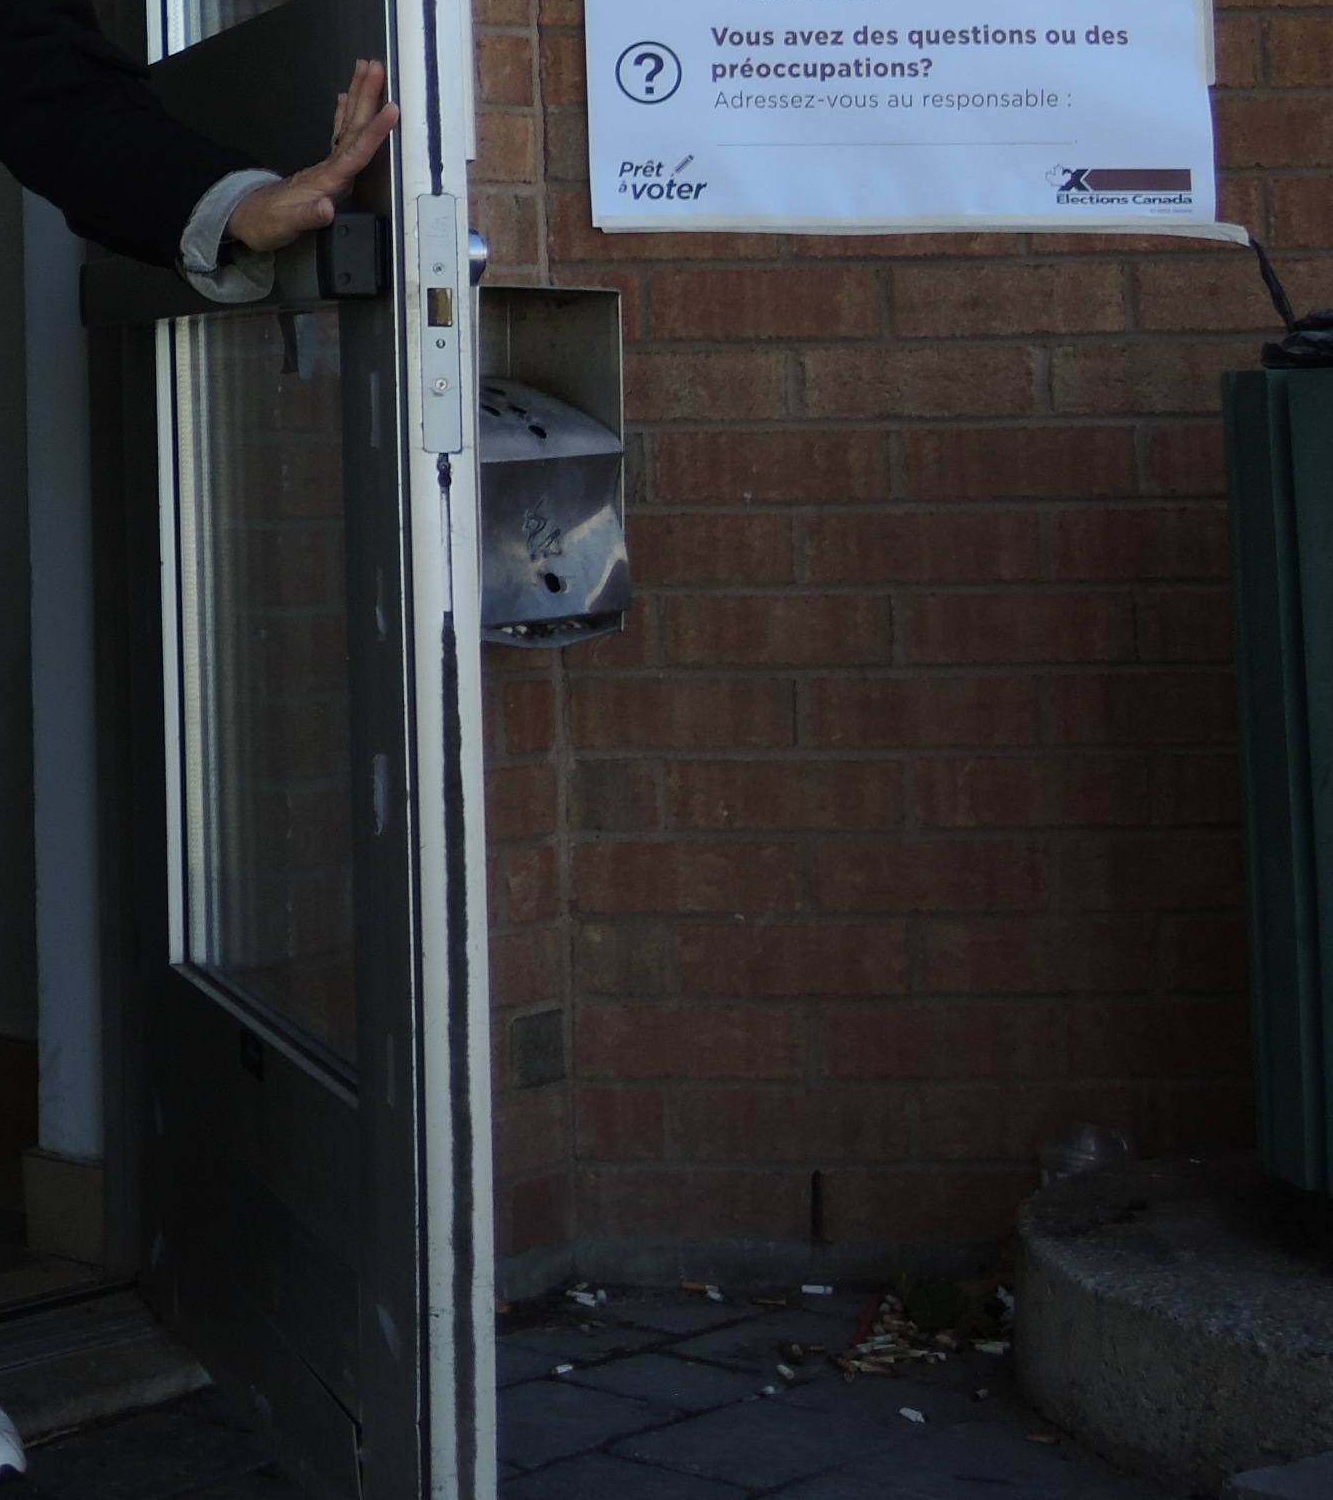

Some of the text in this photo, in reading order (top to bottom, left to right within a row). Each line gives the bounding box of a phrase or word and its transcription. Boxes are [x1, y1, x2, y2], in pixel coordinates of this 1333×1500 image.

[710, 23, 1129, 50] Vous avez des questions ou des
[711, 56, 933, 83] préoccupations?
[713, 89, 879, 109] Adressez-vous
[886, 93, 913, 109] au
[922, 88, 1059, 111] responsable
[618, 159, 664, 178] Prêt
[618, 178, 708, 200] à voter
[1055, 192, 1193, 205] Elections Canada
